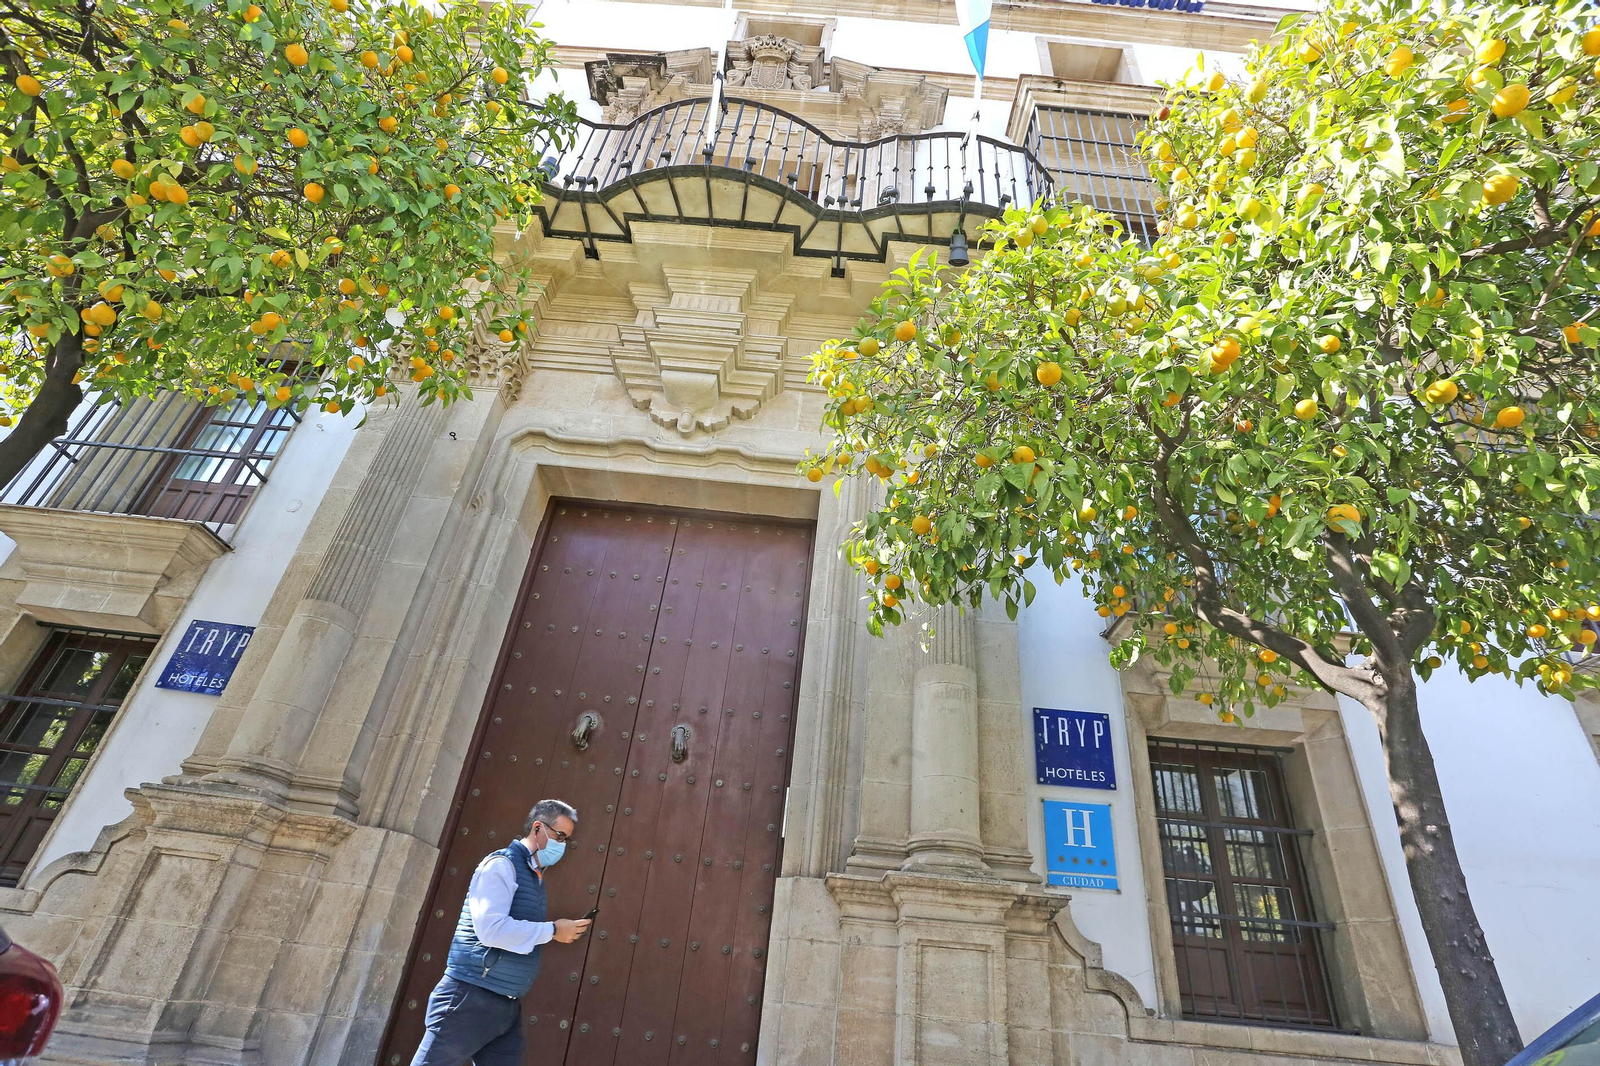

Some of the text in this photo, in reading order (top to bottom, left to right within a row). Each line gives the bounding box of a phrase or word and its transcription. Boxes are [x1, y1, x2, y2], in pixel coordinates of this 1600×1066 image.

[185, 626, 251, 659] TRYP
[168, 673, 225, 689] HOTELES
[1040, 715, 1105, 749] TRYP
[1046, 767, 1106, 782] HOTELES
[1062, 808, 1097, 849] H
[1062, 876, 1104, 888] CIUDAD
